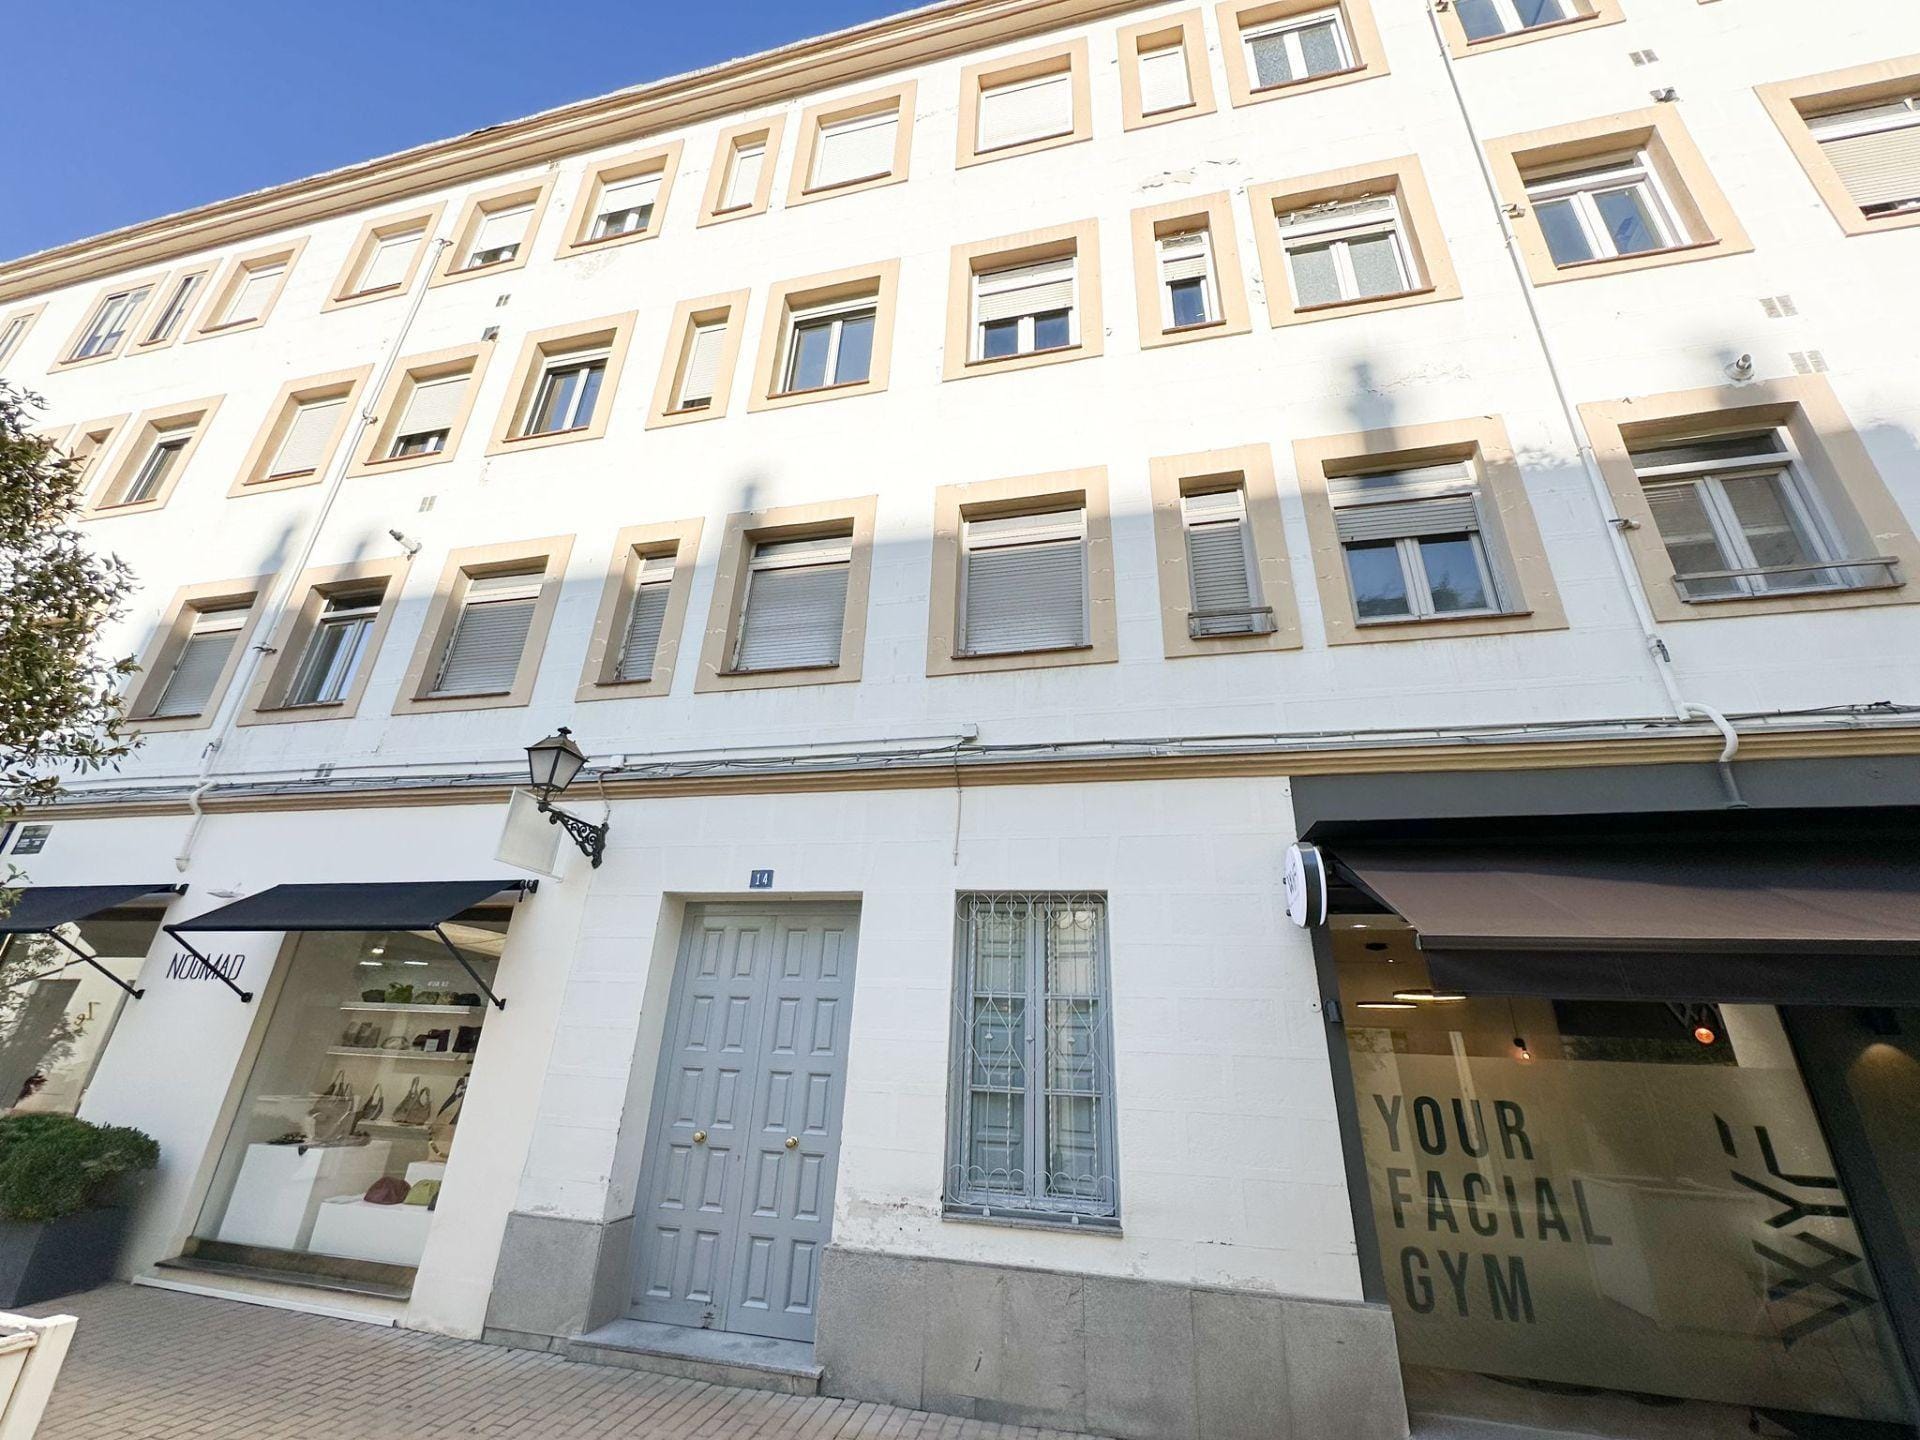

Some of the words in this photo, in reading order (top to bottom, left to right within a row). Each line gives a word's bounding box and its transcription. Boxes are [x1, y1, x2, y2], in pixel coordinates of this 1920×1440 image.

[755, 872, 769, 885] 14
[1372, 1094, 1535, 1161] YOUR
[1386, 1167, 1613, 1246] FACIAL
[1400, 1245, 1537, 1325] GYM
